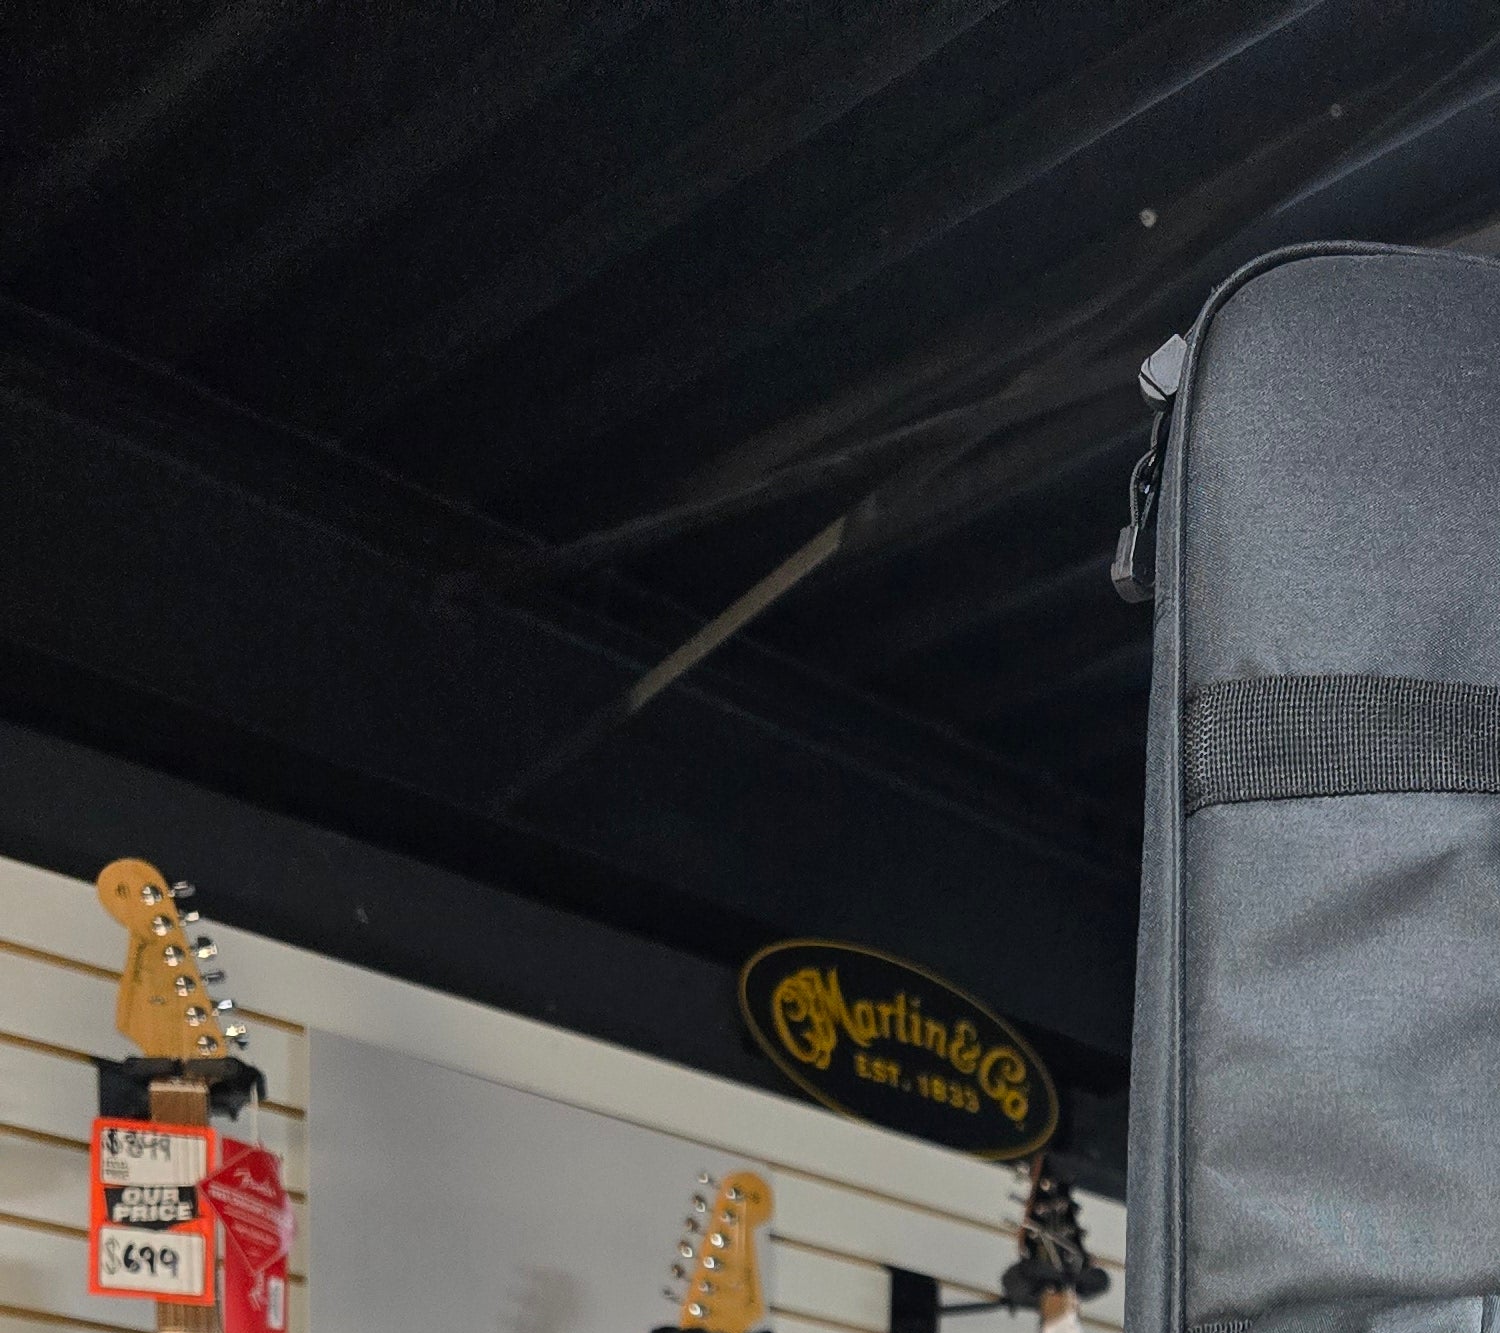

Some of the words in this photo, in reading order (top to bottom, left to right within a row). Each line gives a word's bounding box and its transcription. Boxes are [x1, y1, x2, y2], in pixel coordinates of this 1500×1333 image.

[121, 1187, 179, 1206] OUR
[113, 1203, 194, 1223] PRICE
[104, 1237, 179, 1278] $699
